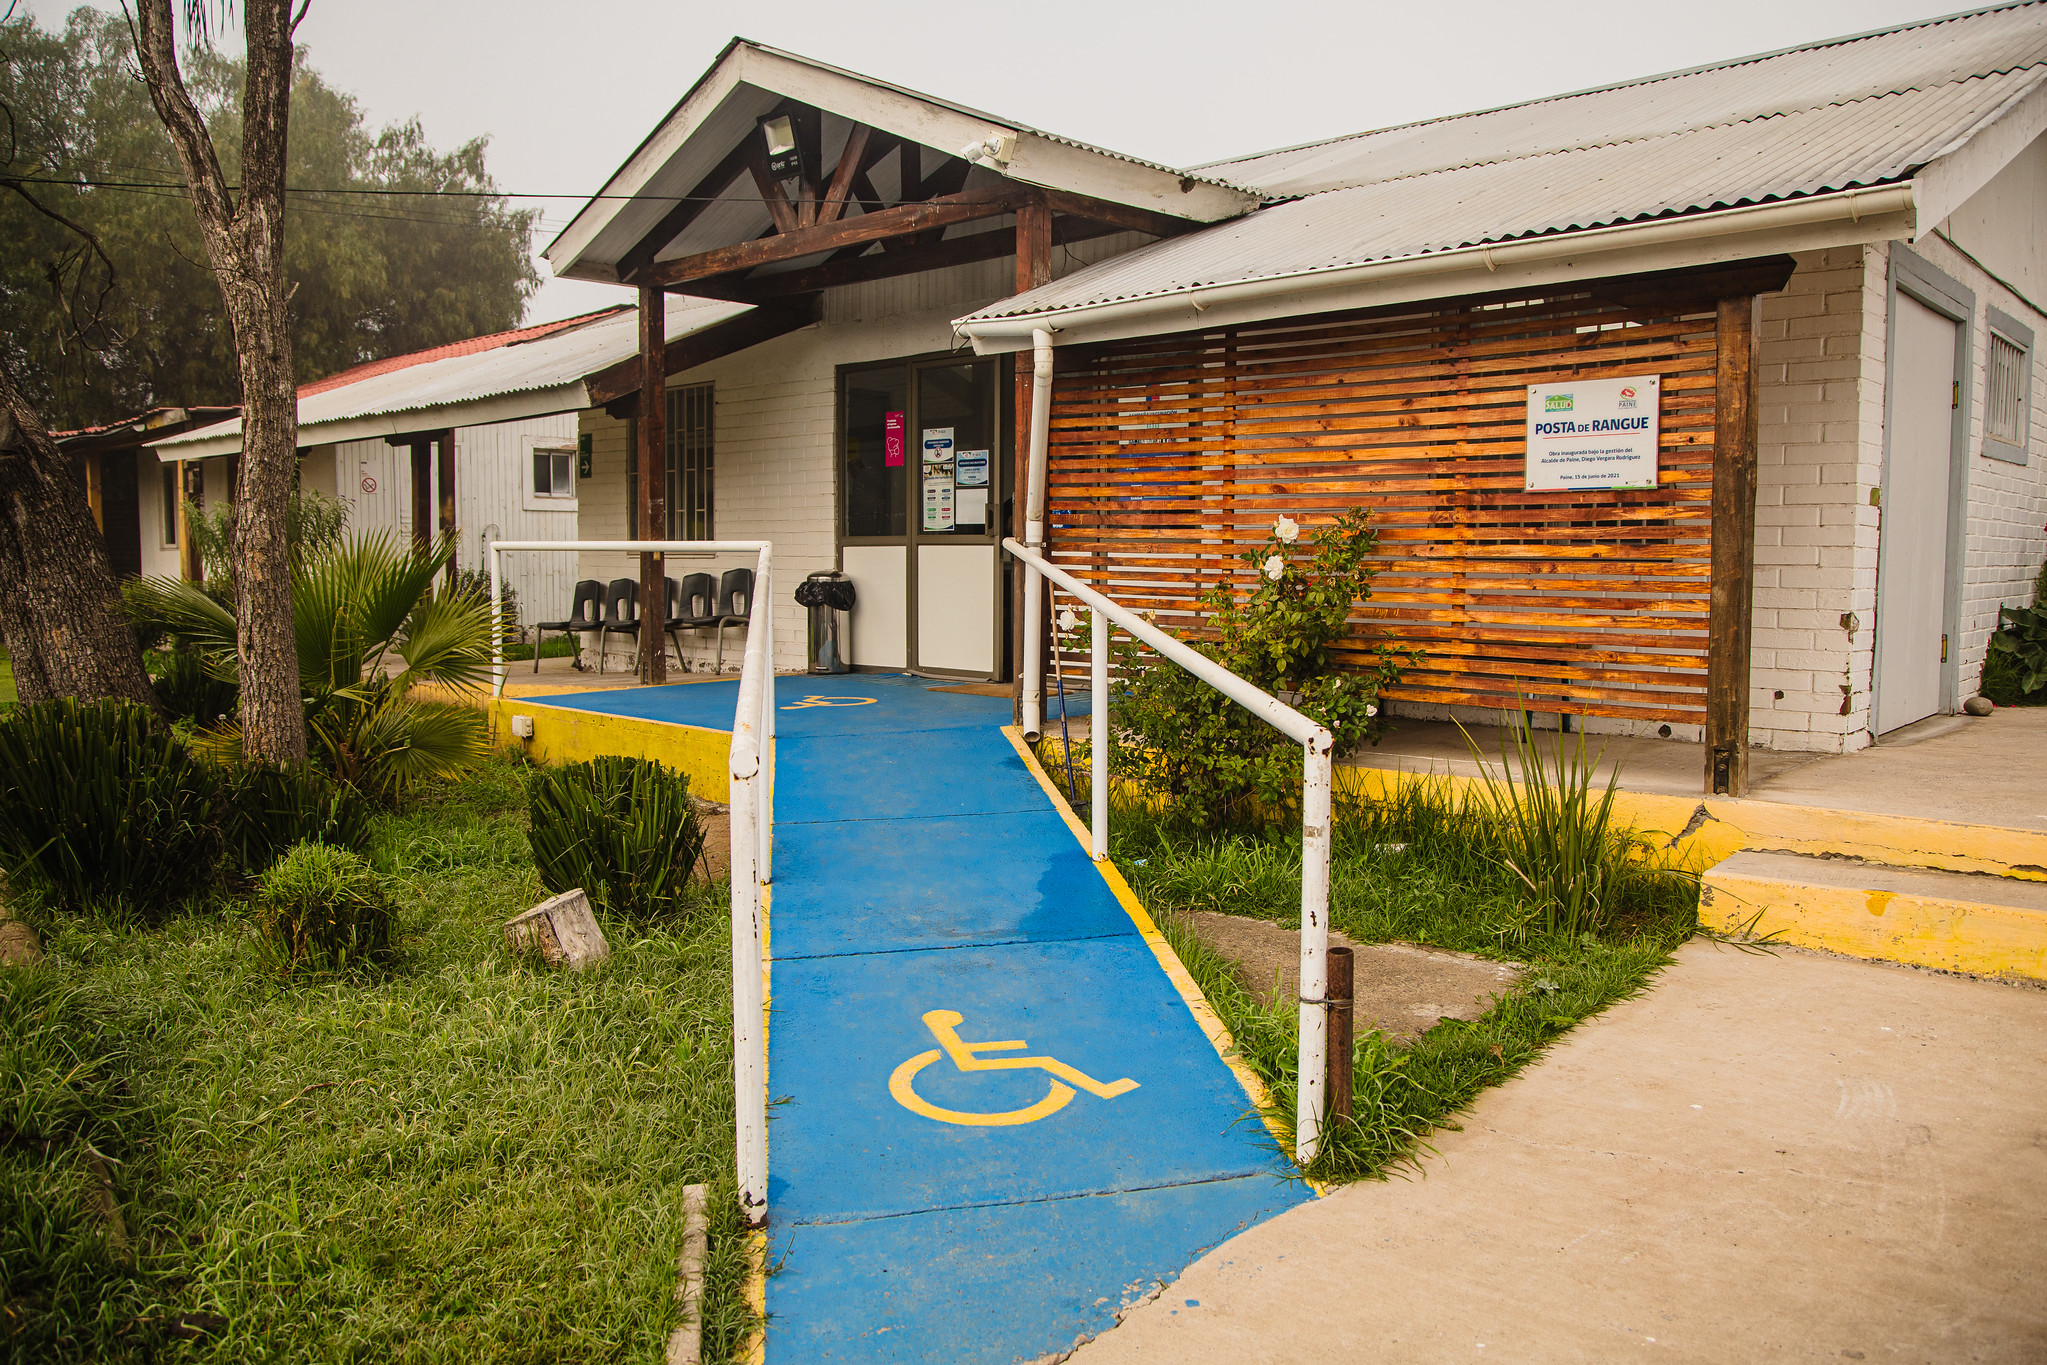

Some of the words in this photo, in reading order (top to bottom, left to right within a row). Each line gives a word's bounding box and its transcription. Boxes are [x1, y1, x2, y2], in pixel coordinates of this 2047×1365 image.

[1546, 400, 1572, 410] SALUD
[1536, 422, 1576, 434] POSTA
[1578, 424, 1590, 432] DE
[1592, 417, 1649, 432] RANGUE
